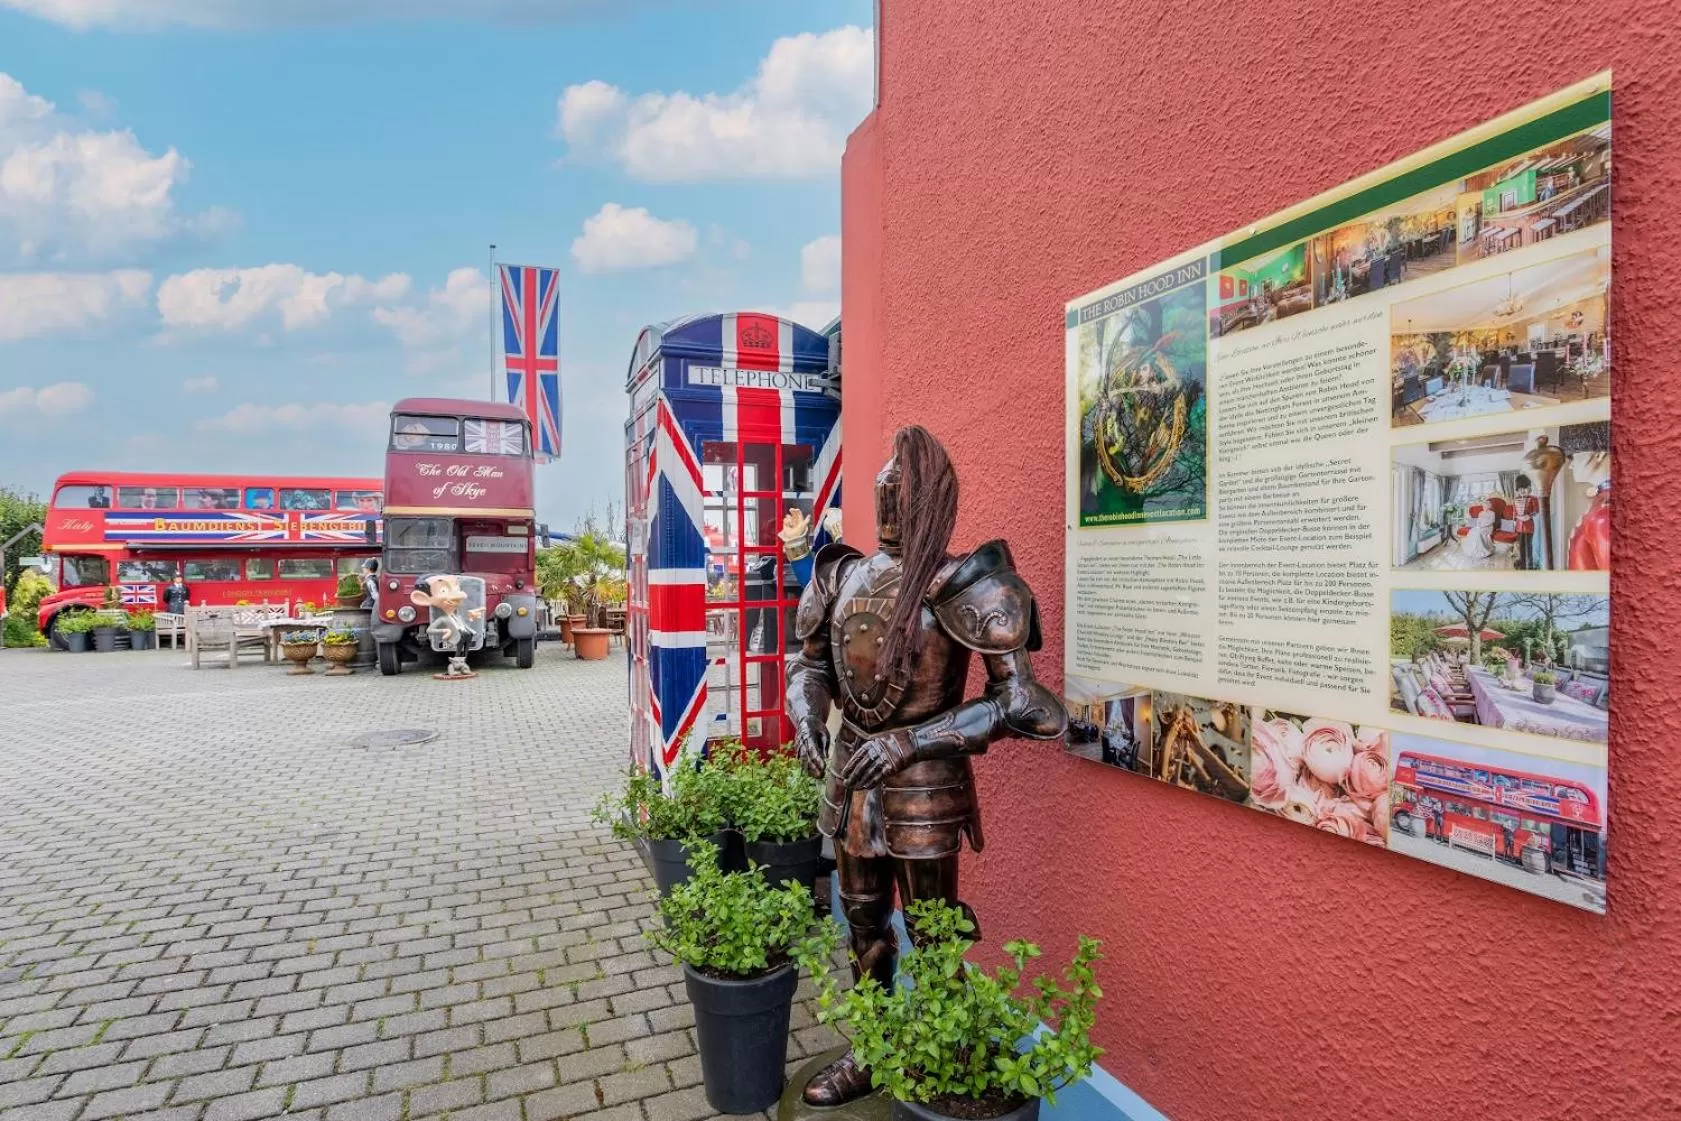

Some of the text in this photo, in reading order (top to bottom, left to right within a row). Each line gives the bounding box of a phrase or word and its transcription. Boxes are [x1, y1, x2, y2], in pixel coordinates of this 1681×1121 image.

[1082, 263, 1201, 321] THE ROBIN HOOD INN
[695, 367, 814, 391] TELEPHONE
[1363, 397, 1376, 405] Tag
[416, 462, 504, 478] The Old Man
[433, 482, 488, 500] of Skye
[154, 516, 263, 532] BAUMDIENST
